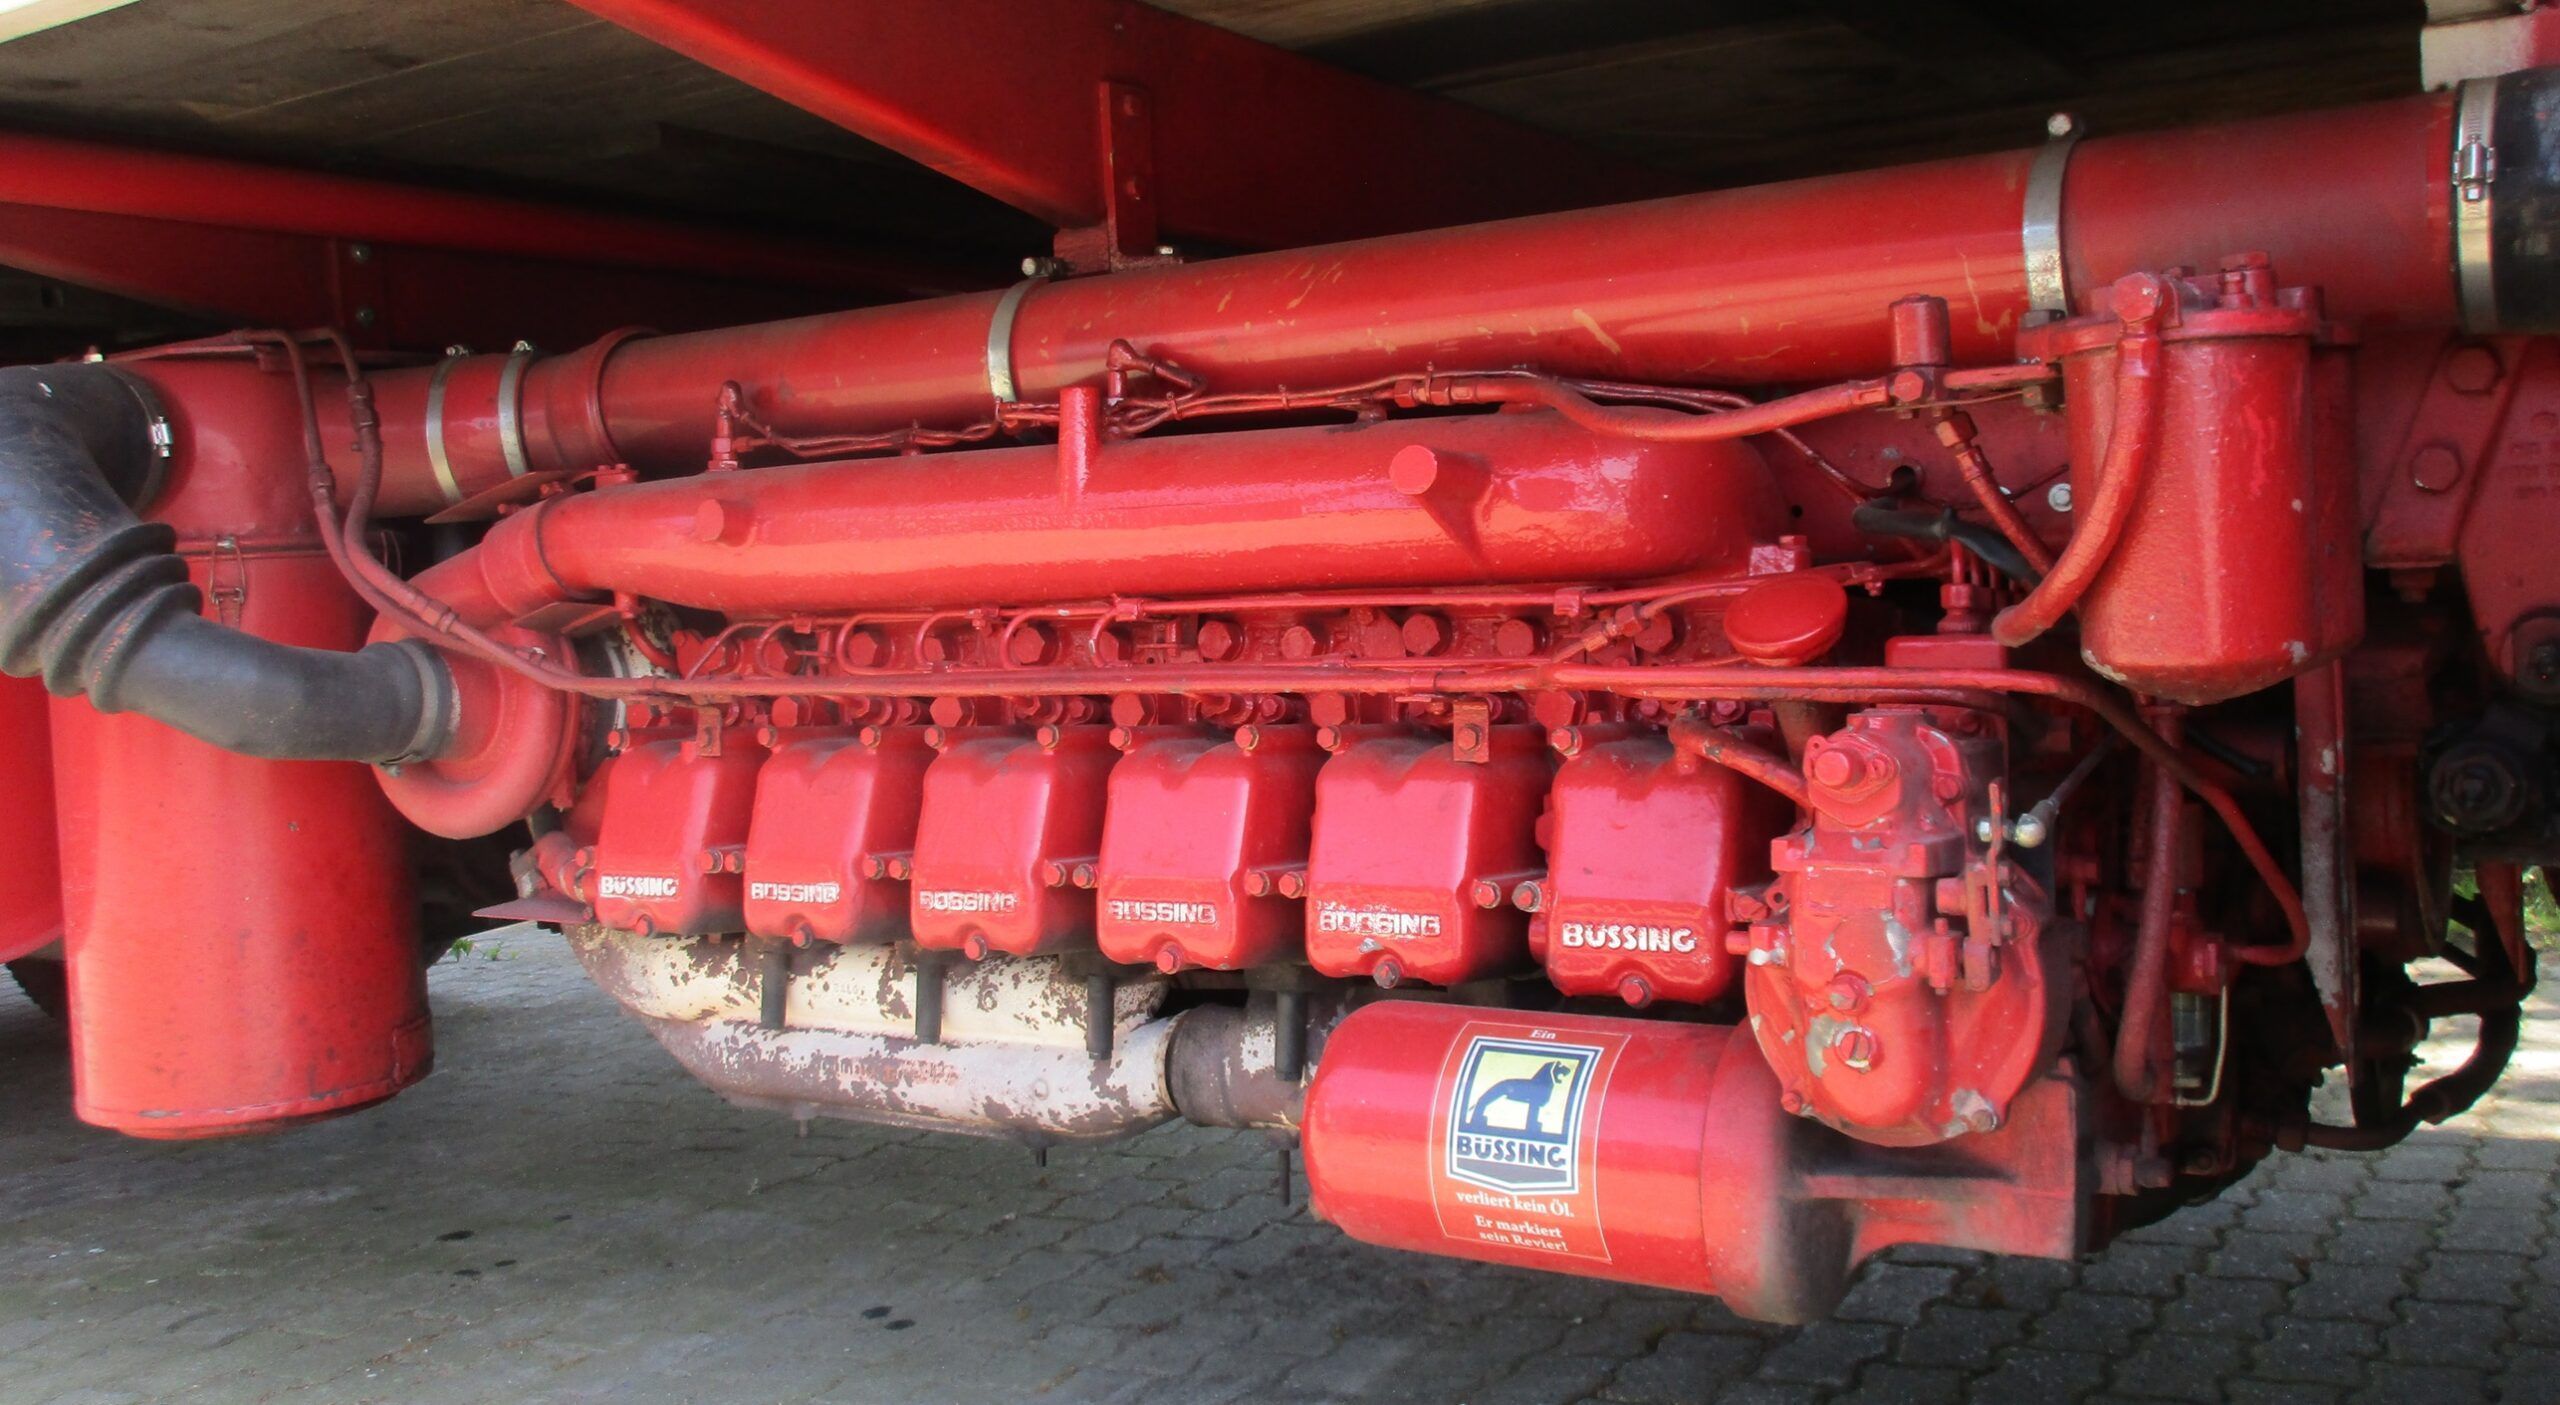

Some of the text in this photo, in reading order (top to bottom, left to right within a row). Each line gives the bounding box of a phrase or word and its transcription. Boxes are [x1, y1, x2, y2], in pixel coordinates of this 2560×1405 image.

[1562, 922, 1697, 952] BÜSSING
[1529, 1029, 1557, 1040] Ein
[1456, 1135, 1566, 1168] BÜSSING
[1456, 1190, 1575, 1218] verliert kein Öl.
[1474, 1214, 1563, 1239] Er markiert
[1479, 1231, 1569, 1252] sein Revier!
